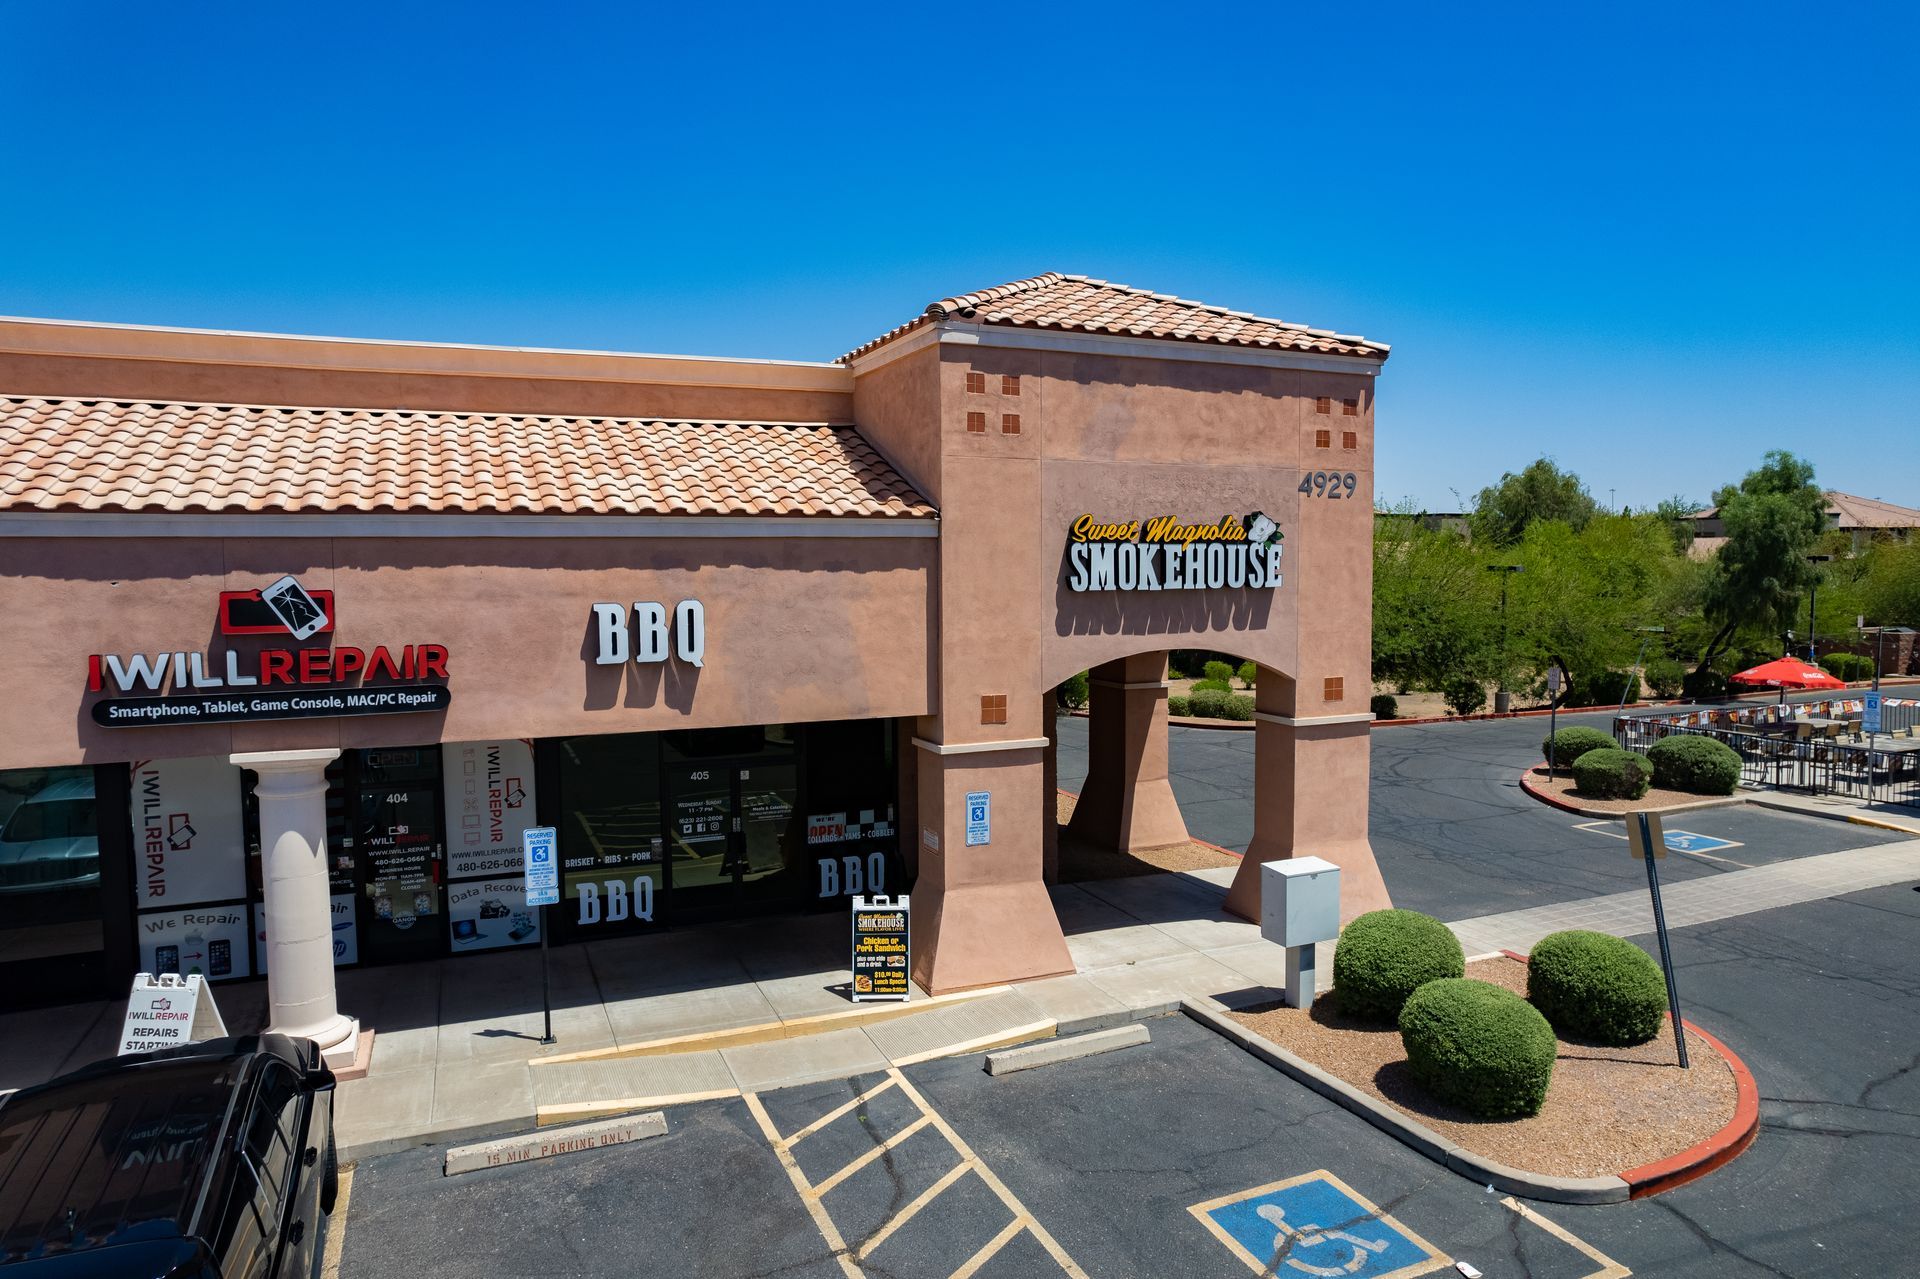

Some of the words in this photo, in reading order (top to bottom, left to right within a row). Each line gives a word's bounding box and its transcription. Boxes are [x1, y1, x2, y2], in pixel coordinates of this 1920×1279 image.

[1298, 471, 1357, 499] 4929
[1072, 514, 1139, 542] Sweet
[1146, 515, 1248, 550] Magnolia
[1070, 543, 1283, 592] SMOKEHOUSE
[593, 599, 705, 668] BBQ
[109, 704, 201, 719] Smartphone,
[203, 700, 249, 714] Tablet,
[251, 699, 289, 711] Game
[291, 696, 344, 710] Console,
[347, 693, 396, 707] MAC/PC
[398, 690, 437, 705] Repair
[690, 771, 709, 780] 405
[386, 793, 408, 803] 404
[808, 835, 838, 844] COLLARDS
[845, 832, 861, 840] YAMS
[867, 829, 895, 838] COBBLER
[809, 824, 844, 838] OPEN
[457, 857, 524, 872] 480-626-066
[565, 857, 595, 868] BRISKET
[604, 854, 621, 864] RIBS
[632, 852, 651, 861] PORK
[818, 852, 884, 898] BBQ
[451, 888, 480, 904] Data
[576, 875, 654, 925] BBQ
[145, 919, 177, 934] We
[183, 913, 241, 925] Repair
[857, 918, 904, 928] SMOKEHOUSE
[856, 944, 873, 952] Pork
[874, 944, 906, 952] Sandwich
[863, 937, 889, 945] Chicken
[133, 1028, 179, 1037] REPAIRS
[487, 1154, 500, 1165] 15
[541, 1137, 595, 1156] PARKING
[601, 1130, 633, 1145] ONLY
